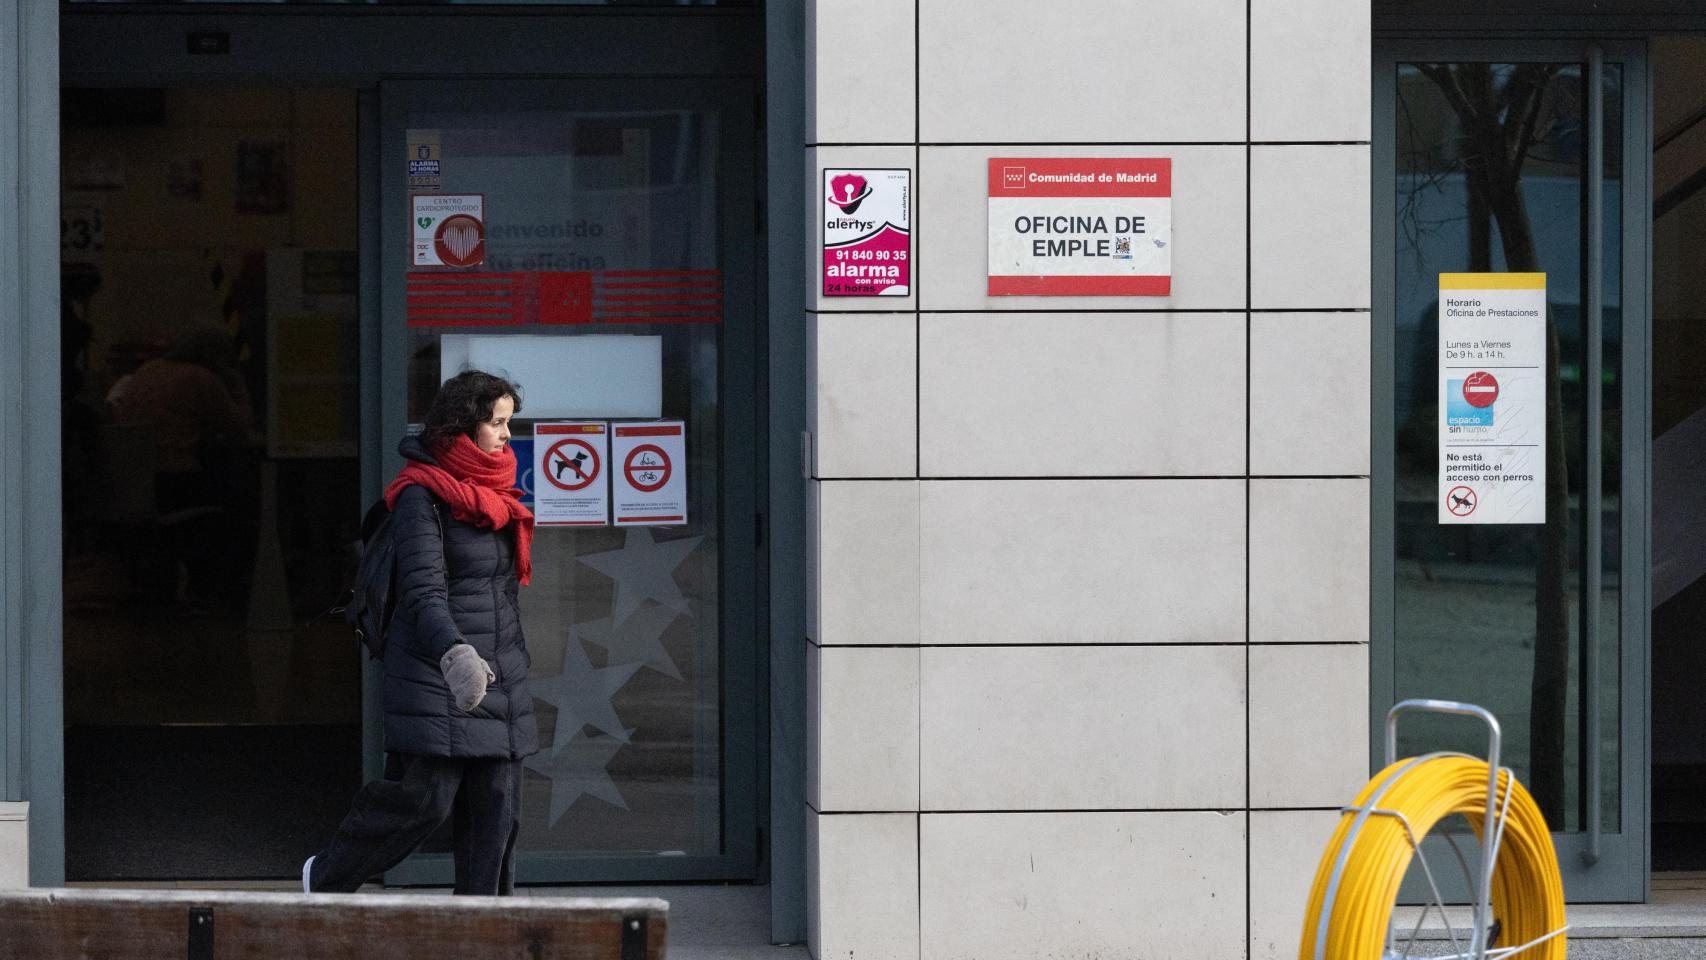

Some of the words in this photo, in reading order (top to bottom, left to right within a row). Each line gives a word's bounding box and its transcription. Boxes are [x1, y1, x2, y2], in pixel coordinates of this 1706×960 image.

[1028, 172, 1095, 183] Comunidad
[1098, 172, 1113, 183] de
[1116, 172, 1157, 183] Madrid
[416, 204, 479, 212] CARDIOPROTEGIDO
[827, 217, 873, 232] alertys
[1014, 215, 1108, 234] OFICINA
[1115, 216, 1146, 233] DE
[1032, 239, 1111, 257] EMPLE
[836, 250, 849, 260] 91
[852, 250, 873, 260] 840
[876, 250, 890, 260] 90
[893, 250, 907, 260] 35
[827, 262, 900, 277] alarma
[873, 277, 896, 285] aviso
[827, 284, 841, 292] 24
[844, 284, 876, 292] horas
[1446, 298, 1481, 307] Horario
[1446, 309, 1474, 317] Oficina
[1476, 309, 1486, 317] de
[1488, 309, 1539, 317] Prestaciones
[1446, 340, 1471, 349] Lunes
[1480, 340, 1512, 349] Viernes
[1446, 350, 1458, 359] De
[1459, 350, 1466, 359] 9
[1467, 350, 1475, 359] h.
[1485, 350, 1495, 359] 14
[1497, 350, 1505, 359] h.
[1449, 415, 1480, 426] espacio
[1449, 425, 1461, 434] sin
[1446, 453, 1460, 461] No
[1462, 453, 1483, 461] está
[1446, 463, 1491, 472] permitido
[1494, 463, 1503, 471] el
[1502, 474, 1533, 483] perros
